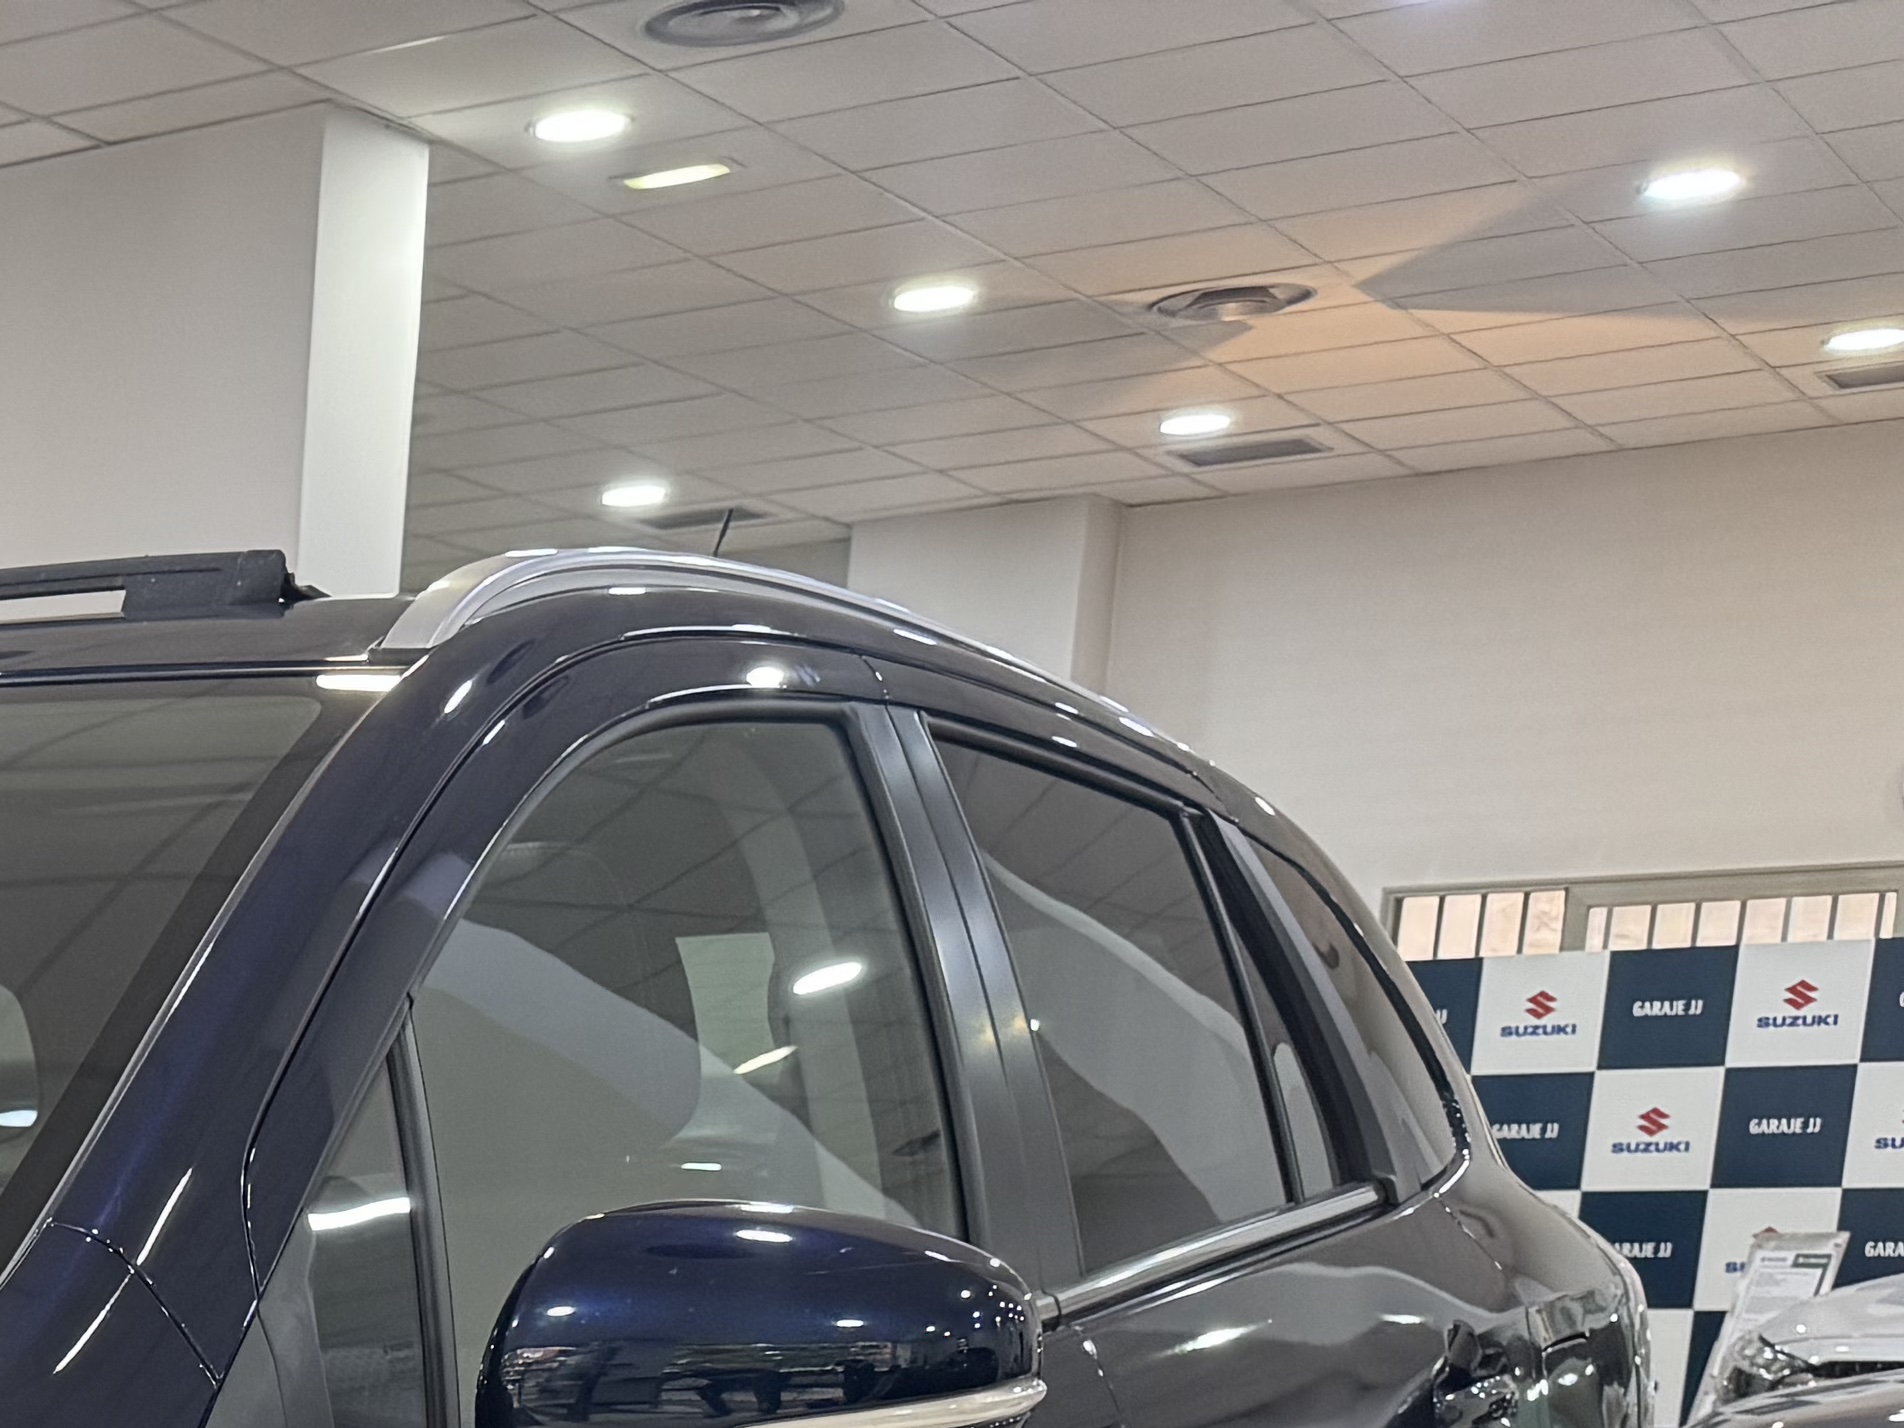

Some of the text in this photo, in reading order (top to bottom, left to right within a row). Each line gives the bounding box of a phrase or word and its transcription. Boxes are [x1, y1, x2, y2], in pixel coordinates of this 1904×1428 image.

[1632, 1001, 1689, 1017] GARAJE
[1756, 1014, 1839, 1029] SUZUKI
[1500, 1023, 1577, 1038] SUZUKI
[1749, 1117, 1822, 1135] GARAJE JJ
[1611, 1140, 1690, 1154] SUZUKI
[1875, 1137, 1904, 1149] SU
[1614, 1242, 1656, 1258] ARAJE
[1865, 1241, 1904, 1257] GARA
